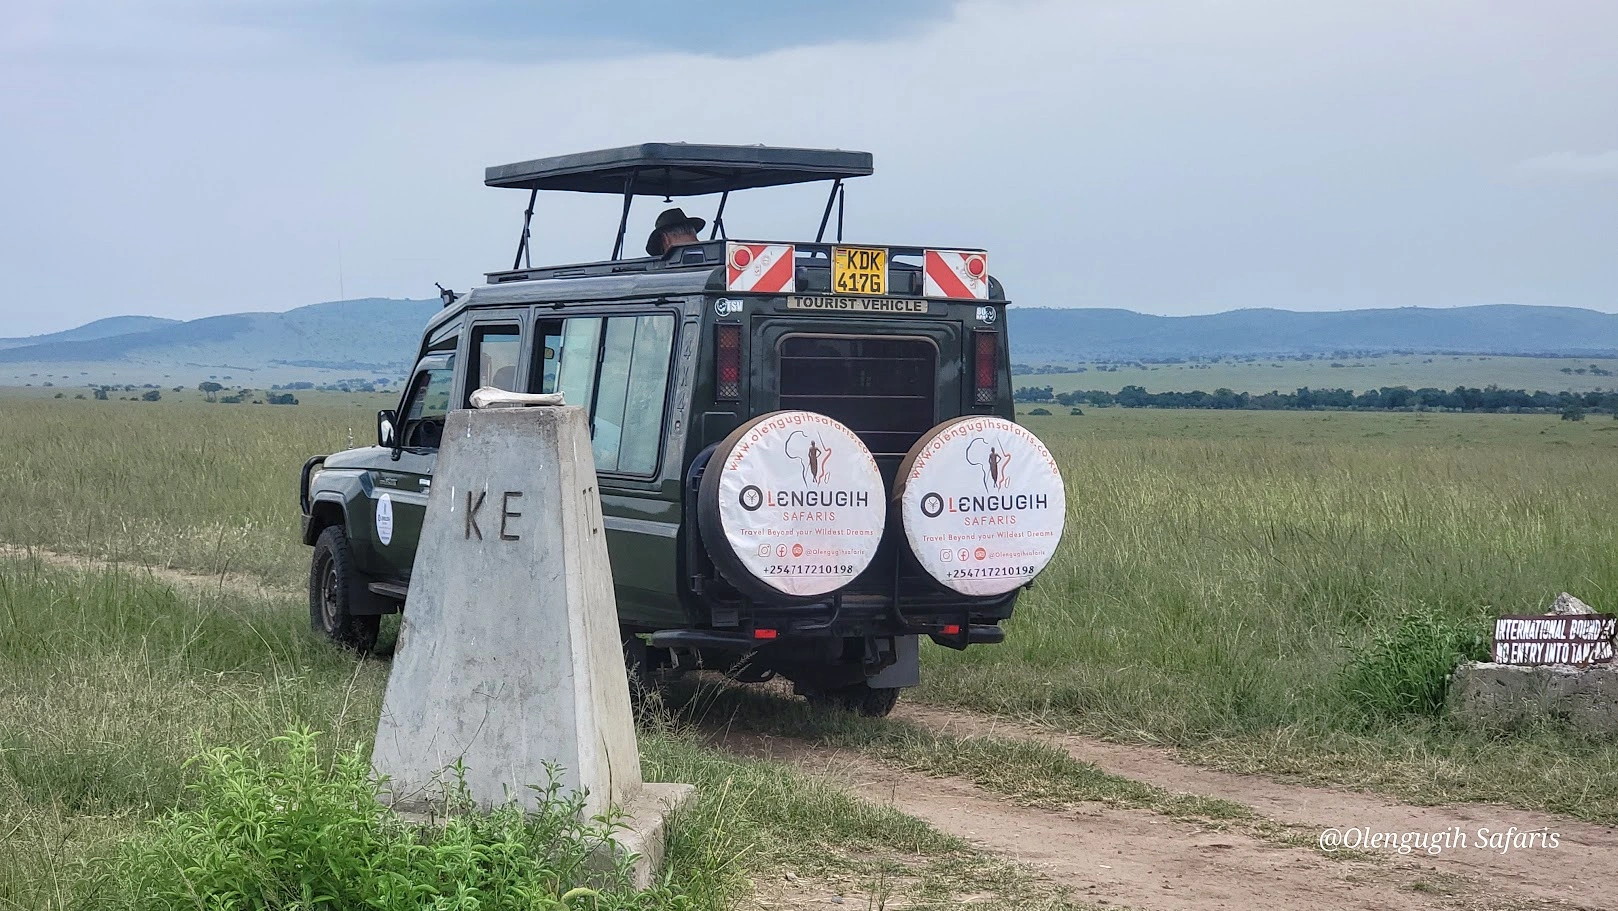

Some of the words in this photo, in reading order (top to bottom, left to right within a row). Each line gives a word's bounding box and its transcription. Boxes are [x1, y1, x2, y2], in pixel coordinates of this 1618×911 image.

[847, 250, 881, 271] KDK
[837, 272, 881, 292] 417G
[794, 296, 857, 310] TOURIST
[860, 299, 922, 312] VEHICLE
[729, 412, 878, 472] www.olengugihsafaris.co.ke
[911, 419, 1058, 479] www.olengugihsafaris.co.ke
[738, 484, 868, 511] OLENGUGIH
[920, 492, 1048, 518] OLENGUGIH
[465, 490, 524, 541] KE
[782, 511, 835, 521] SAFARIS
[964, 515, 1016, 526] SAFARIS
[740, 528, 765, 536] Travel
[767, 528, 794, 537] Beyond
[815, 528, 844, 536] Wildest
[846, 528, 874, 536] Dreams
[923, 534, 946, 542] Travel
[948, 533, 976, 542] Beyond
[978, 533, 995, 541] your
[997, 531, 1025, 539] Wildest
[1027, 530, 1054, 538] Dreams
[763, 564, 853, 575] +254717210198
[946, 566, 1035, 579] +254717210198
[1495, 619, 1566, 640] INTERNATIONAL
[1496, 643, 1509, 664] NO
[1511, 642, 1544, 663] ENTRY
[1544, 642, 1569, 663] INTO
